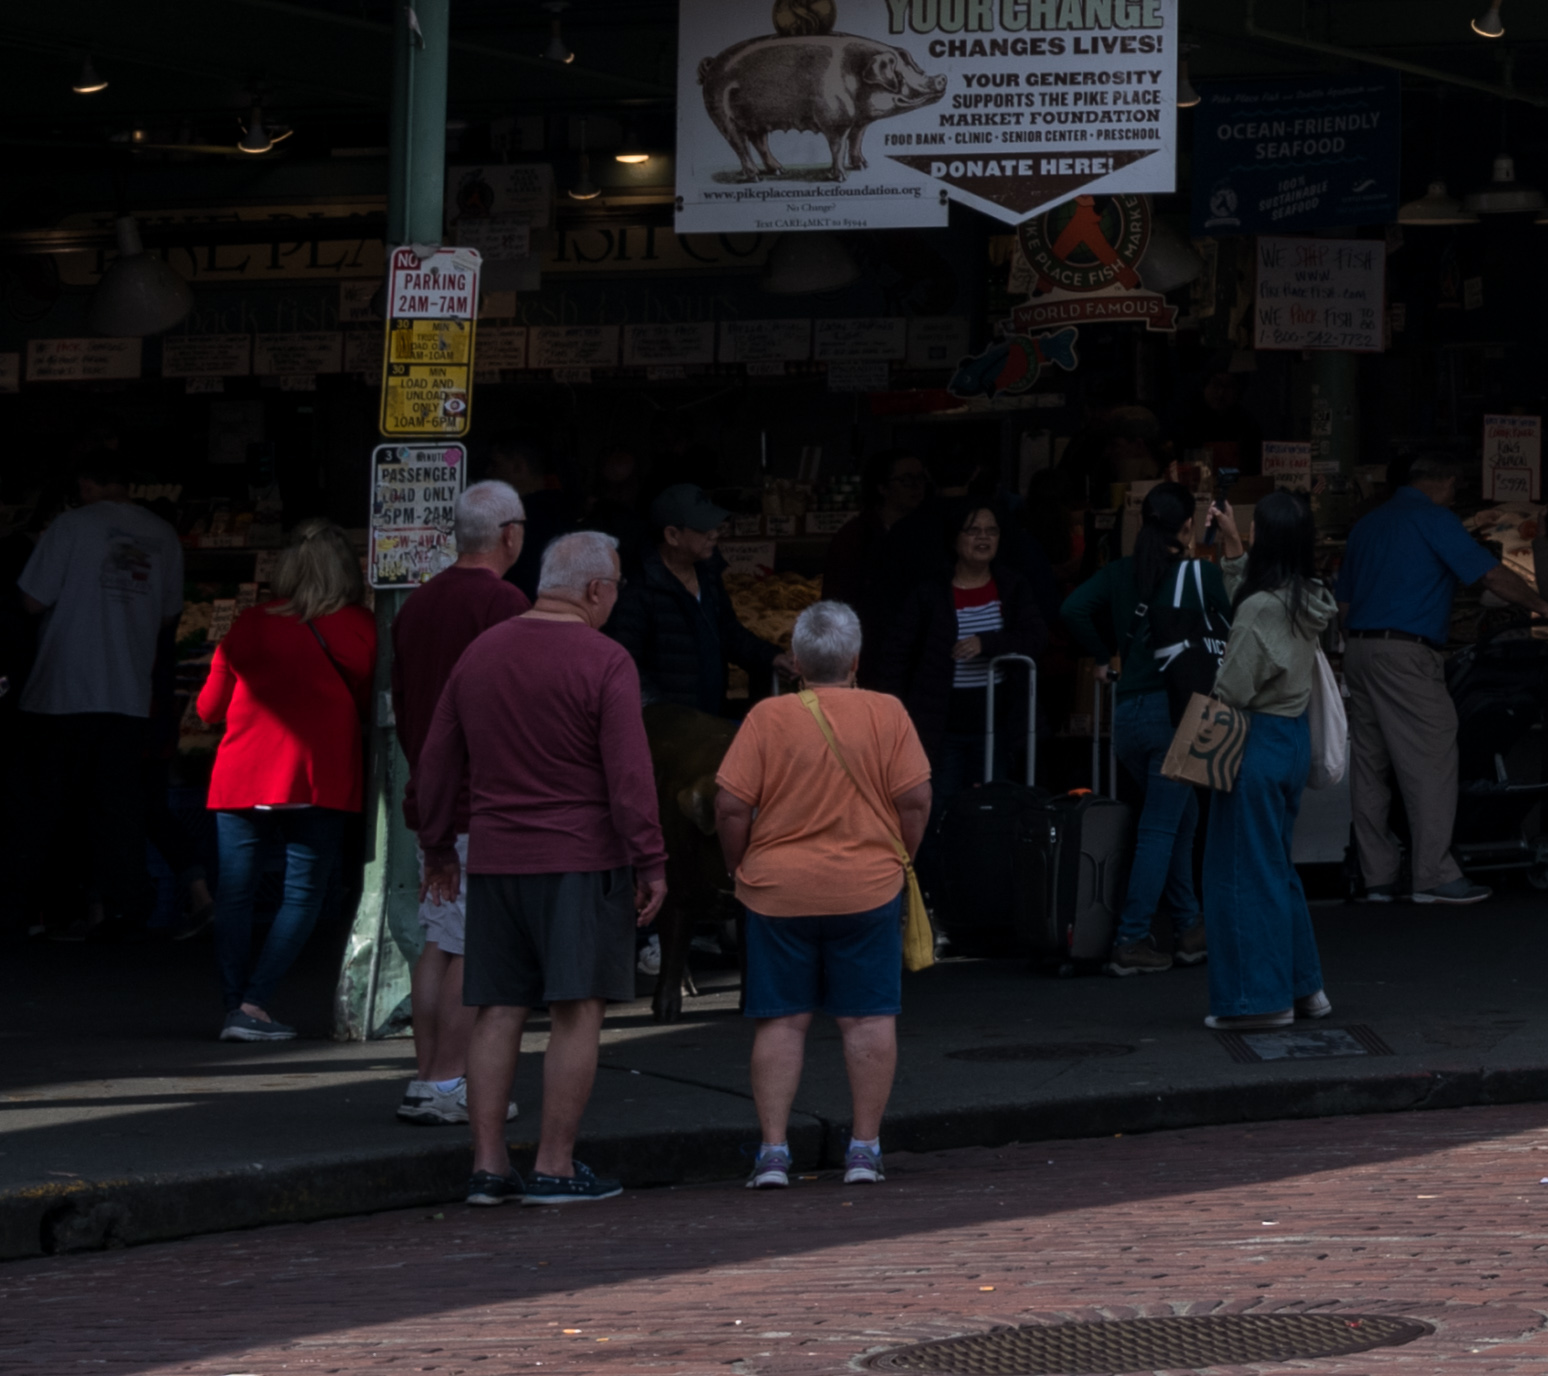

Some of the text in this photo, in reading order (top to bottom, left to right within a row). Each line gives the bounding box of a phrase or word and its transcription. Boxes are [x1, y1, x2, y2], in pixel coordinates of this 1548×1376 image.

[928, 35, 1163, 58] CHANGES LIVES!
[962, 70, 1163, 88] YOUR GENEROSITY
[952, 90, 1162, 109] SUPPORTS THE PIKE PLACE
[938, 109, 1160, 127] MARKET FOUNDATION
[1216, 111, 1381, 142] OCEAN-FRIENDLY
[884, 127, 1161, 146] FOOD BANK CLINIC SENIOR CENTER PRESCHOOL
[1254, 136, 1346, 160] SEAFOOD
[930, 157, 1115, 178] DONATE HERE!
[703, 185, 922, 201] www.pikeplacemarketfoundation.org
[1258, 179, 1329, 213] SUSTAINABLE
[786, 201, 837, 214] No Change?
[1271, 197, 1320, 221] SEAFOOD
[755, 219, 775, 228] Text
[397, 252, 418, 268] NO
[1260, 243, 1287, 268] WE
[1035, 251, 1125, 286] PLACE FISH
[403, 273, 466, 291] PARKING
[398, 295, 468, 313] 2AM-7AM
[1018, 300, 1160, 322] WORLD FAMOUS
[1260, 307, 1283, 326] WE
[432, 322, 450, 332] MIN
[391, 364, 447, 377] 30 MIN
[400, 378, 454, 390] LOAD AND
[412, 402, 440, 413] ONLY
[393, 416, 457, 428] 10AM-6PM
[382, 467, 457, 483] PASSENGER
[383, 486, 455, 503] LOAD ONLY
